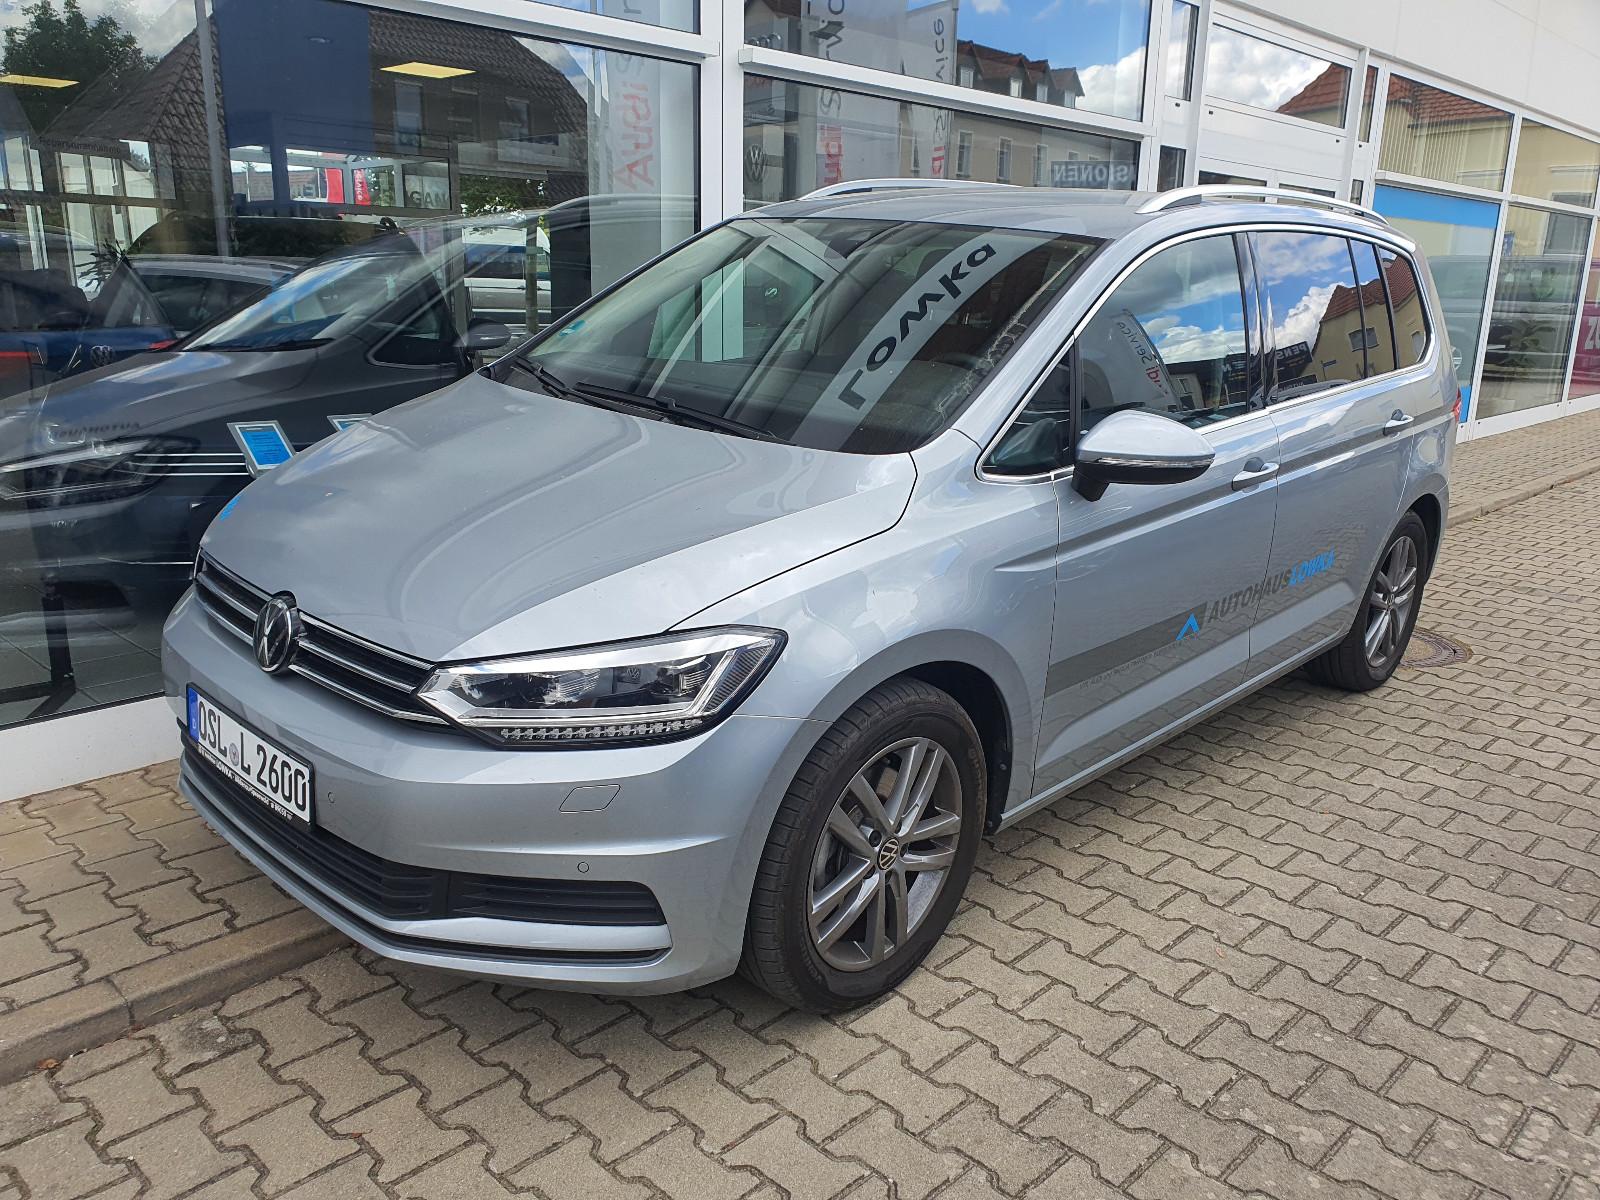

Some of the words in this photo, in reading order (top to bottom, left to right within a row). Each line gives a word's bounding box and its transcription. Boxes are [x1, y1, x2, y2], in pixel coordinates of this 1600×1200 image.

[819, 123, 844, 184] udi
[198, 701, 228, 758] OSL
[240, 731, 251, 776] L
[256, 744, 307, 812] 2600
